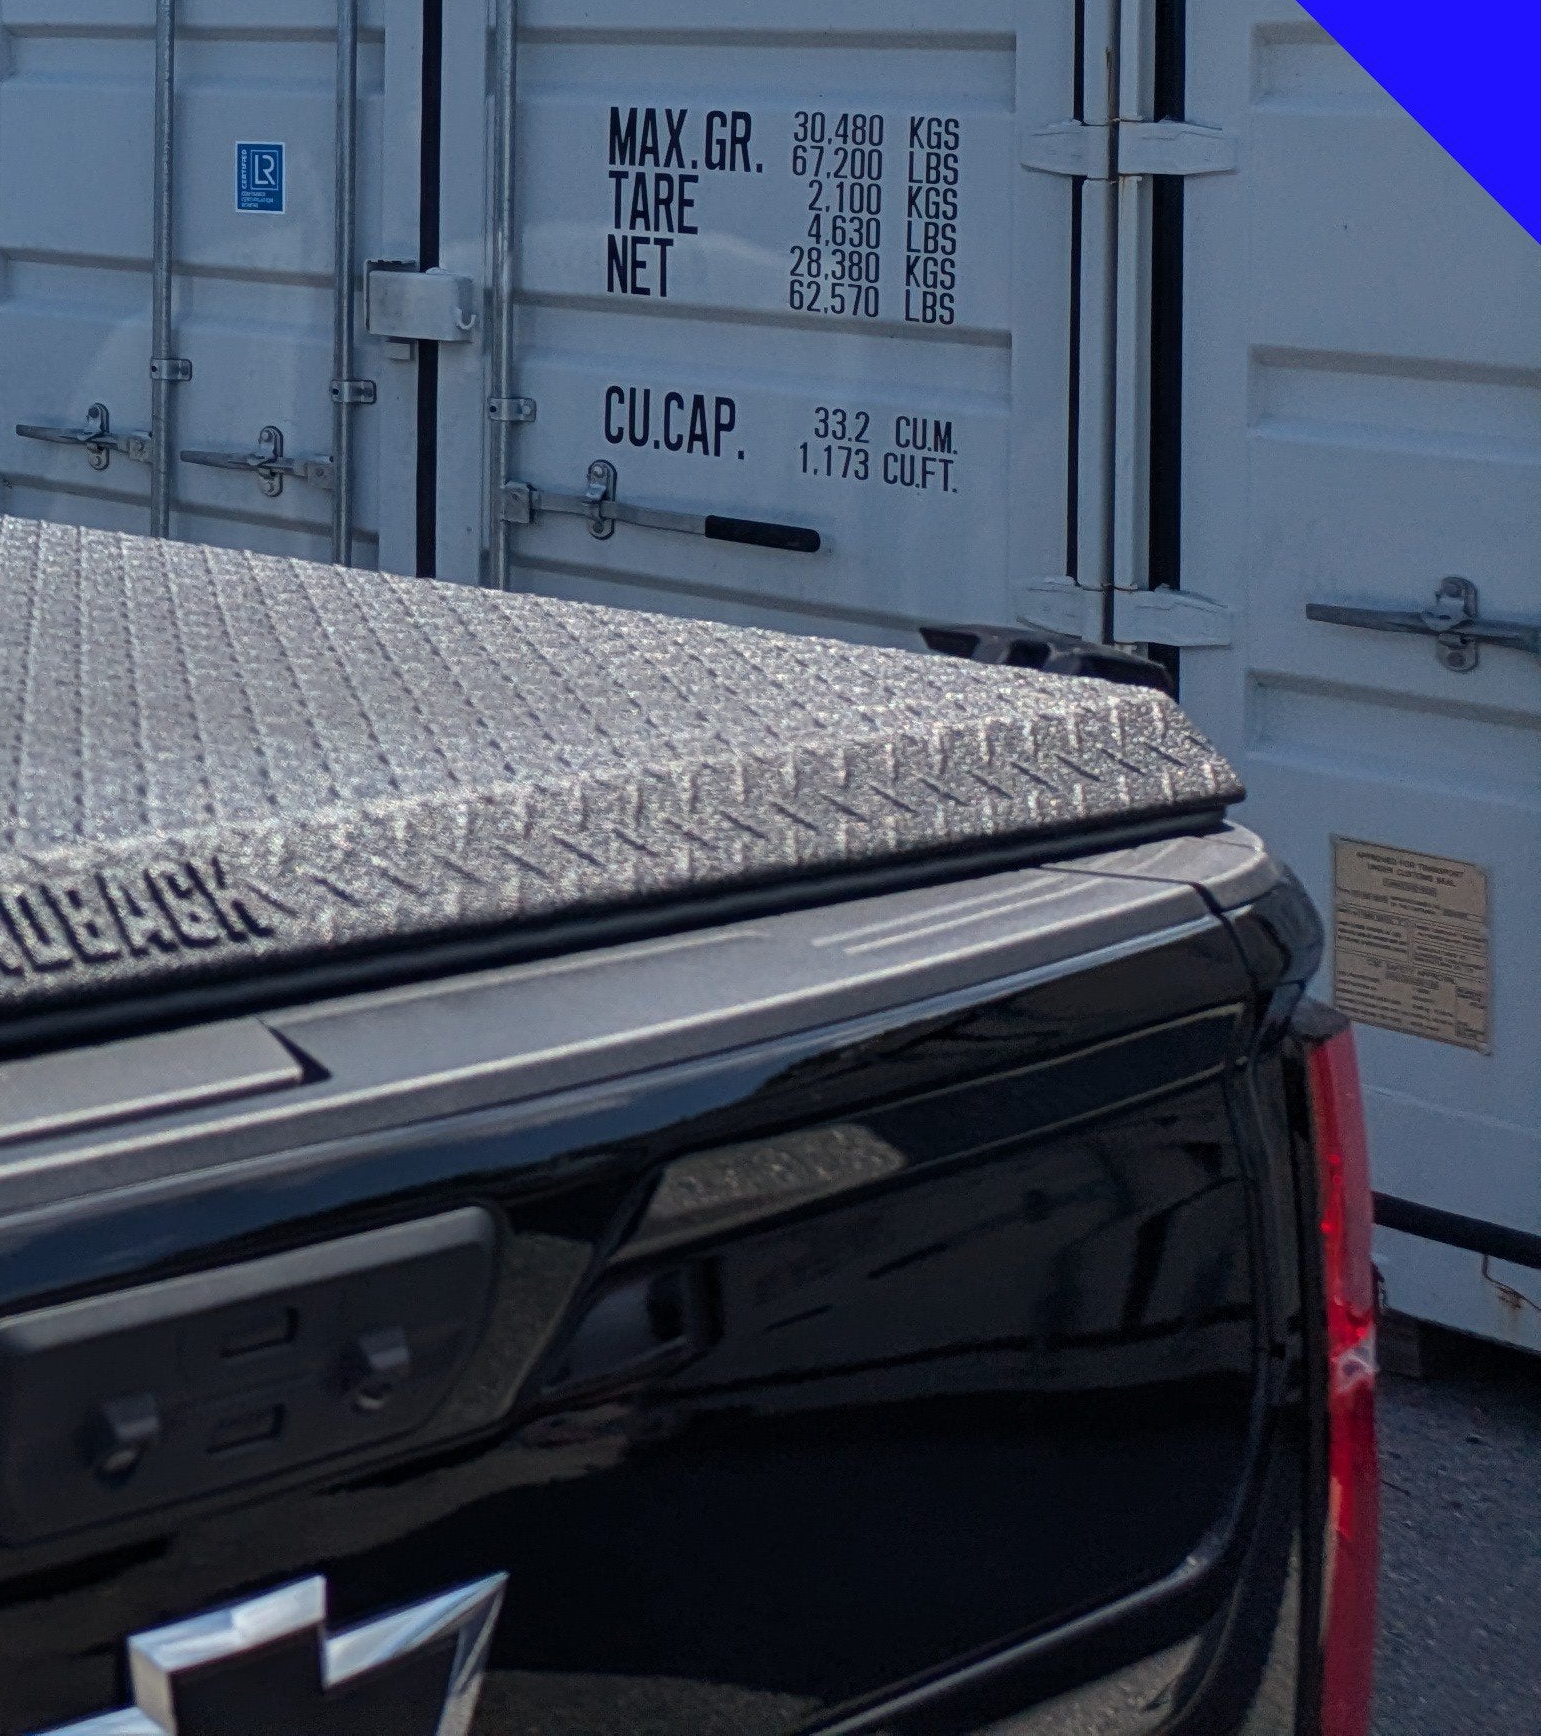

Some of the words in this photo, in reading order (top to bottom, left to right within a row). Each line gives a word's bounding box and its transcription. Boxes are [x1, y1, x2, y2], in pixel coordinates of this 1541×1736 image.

[910, 117, 959, 152] KGS
[909, 151, 958, 185] LBS
[608, 168, 698, 236] TARE
[908, 184, 957, 220] KGS
[907, 219, 956, 256] LBS
[605, 234, 673, 300] NET
[906, 254, 955, 291] KGS
[905, 288, 954, 325] LBS
[601, 386, 744, 462] CU.CAP.
[815, 407, 869, 443] 33.2
